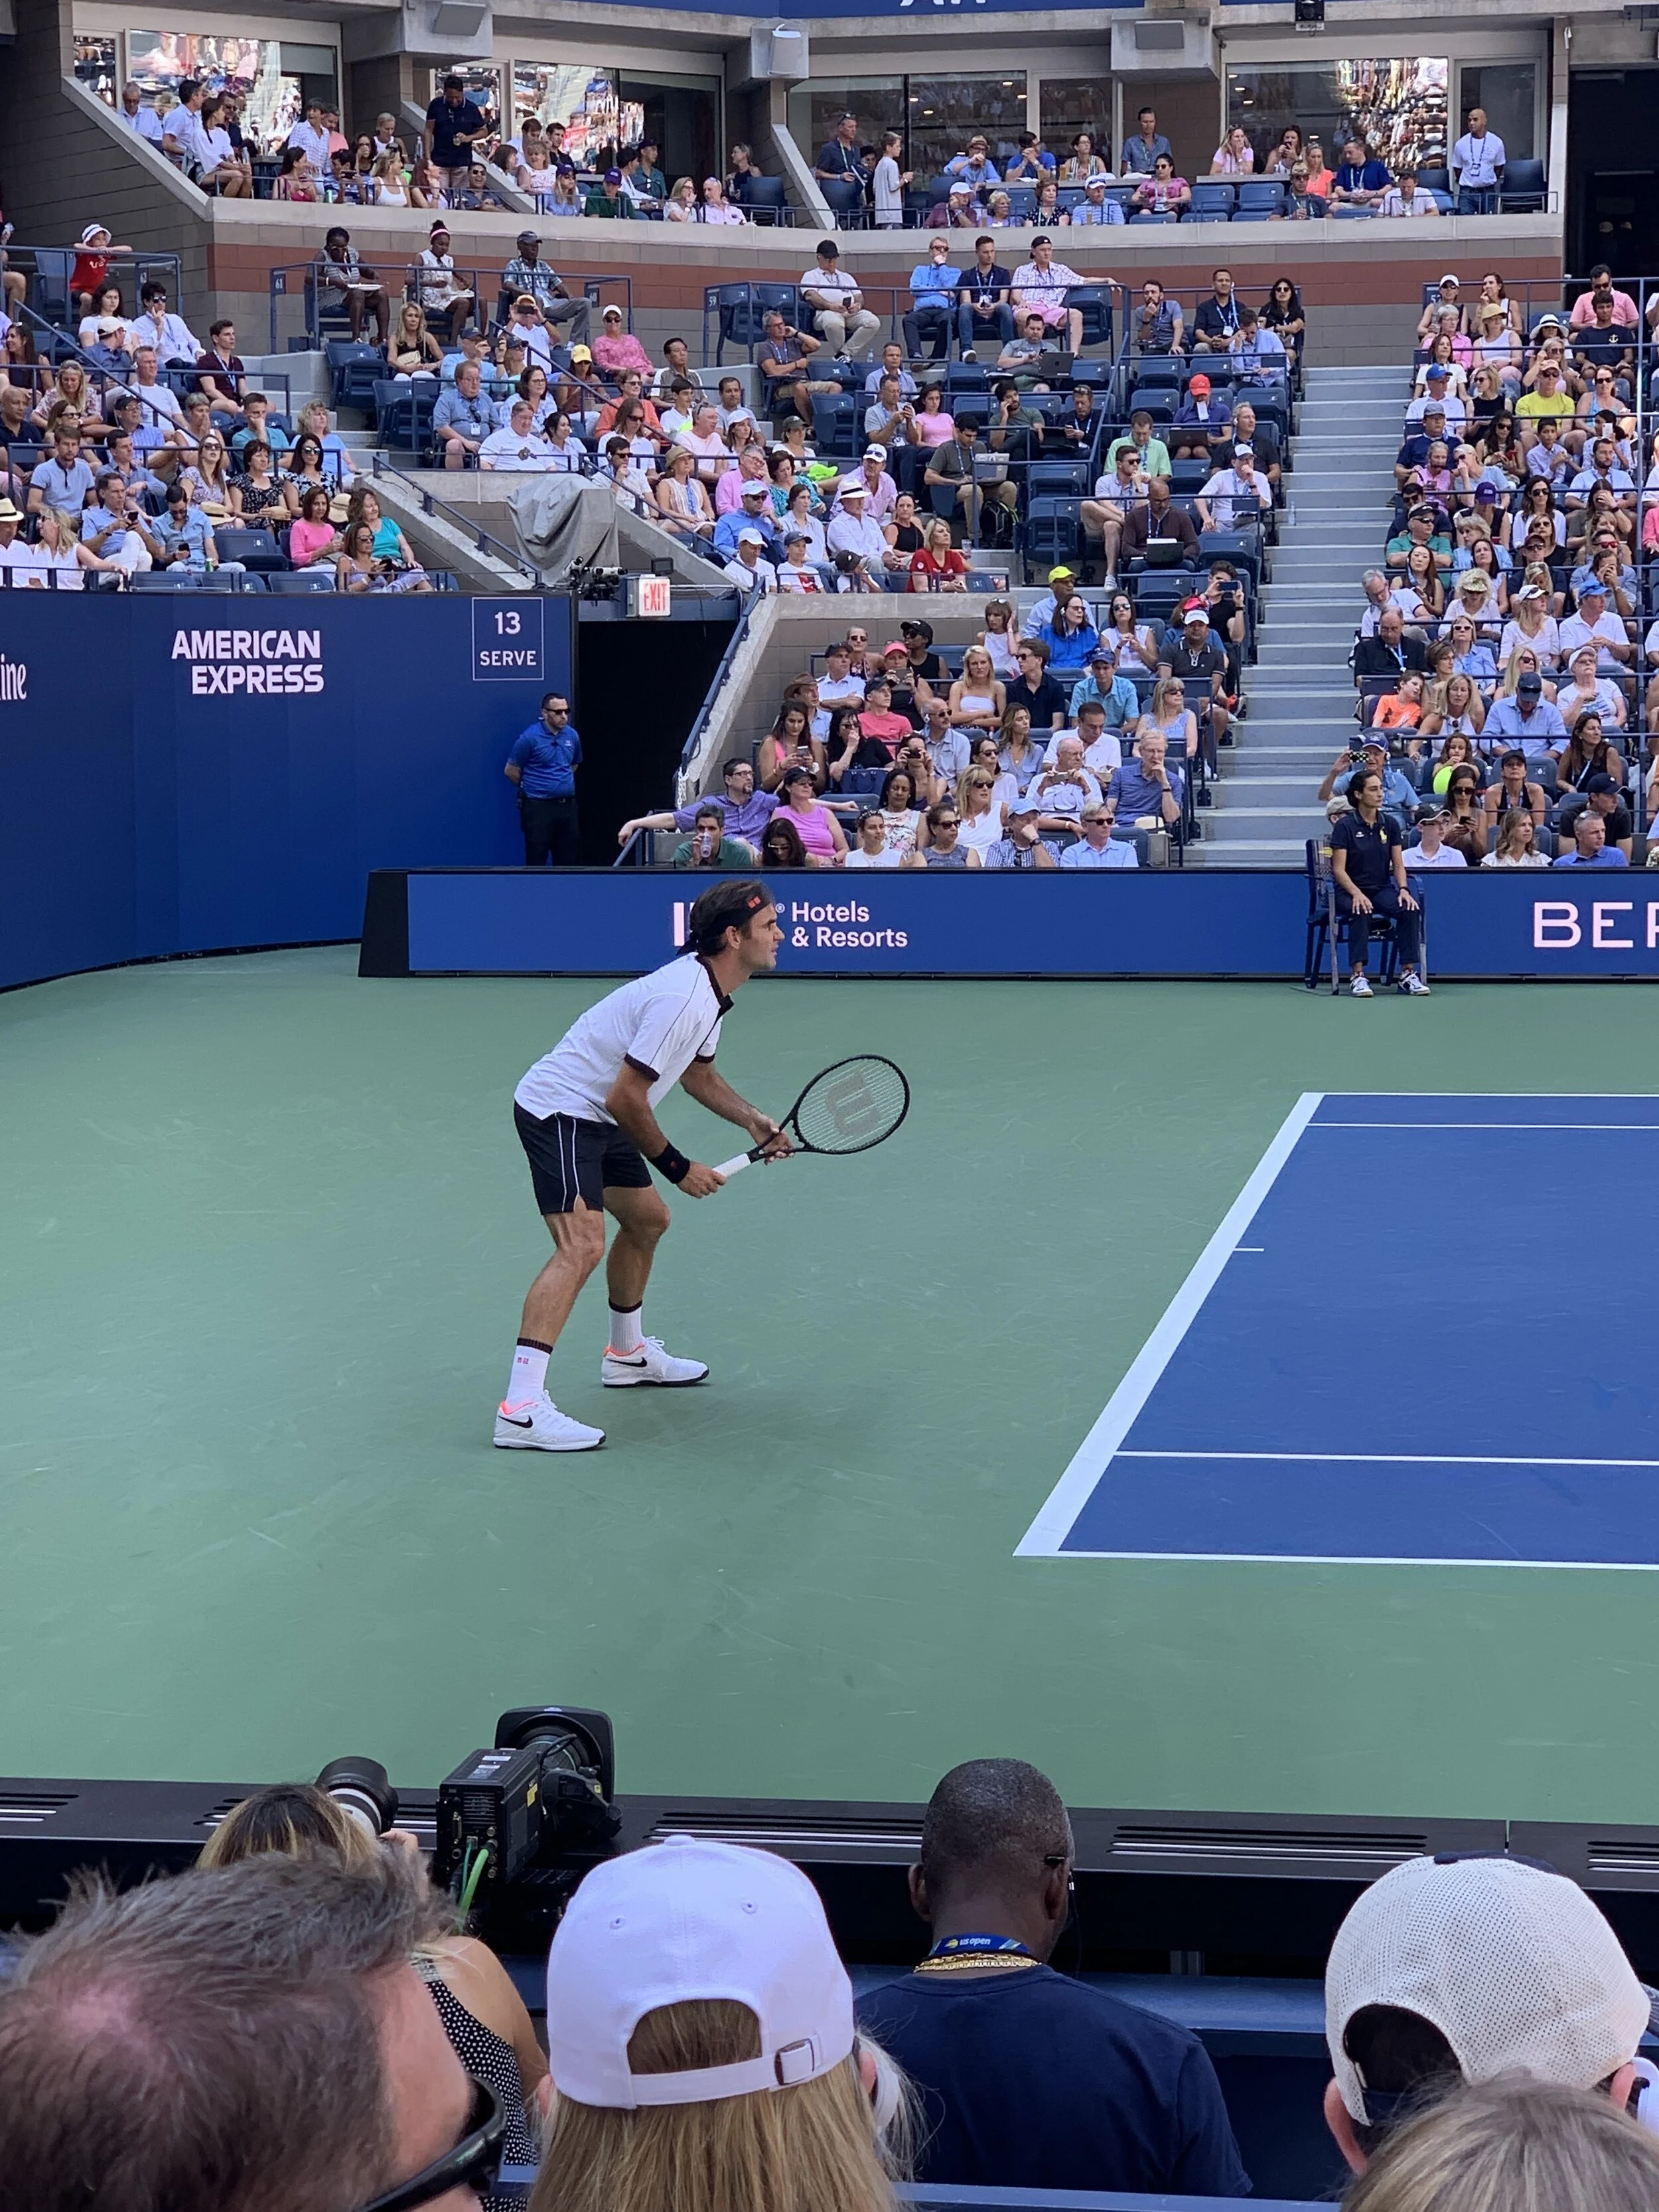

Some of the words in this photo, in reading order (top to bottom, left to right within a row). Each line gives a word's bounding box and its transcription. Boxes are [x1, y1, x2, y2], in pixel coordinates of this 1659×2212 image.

[275, 277, 283, 289] 61
[709, 295, 717, 307] 59
[643, 583, 666, 611] EXIT
[494, 611, 521, 634] 13
[171, 630, 321, 660] AMERICAN
[480, 650, 537, 666] SERVE
[0, 653, 27, 700] ine
[191, 664, 325, 694] EXPRESS
[792, 901, 869, 922] Hotels
[792, 926, 809, 947] &
[816, 926, 908, 947] Resorts
[970, 1937, 991, 1947] open
